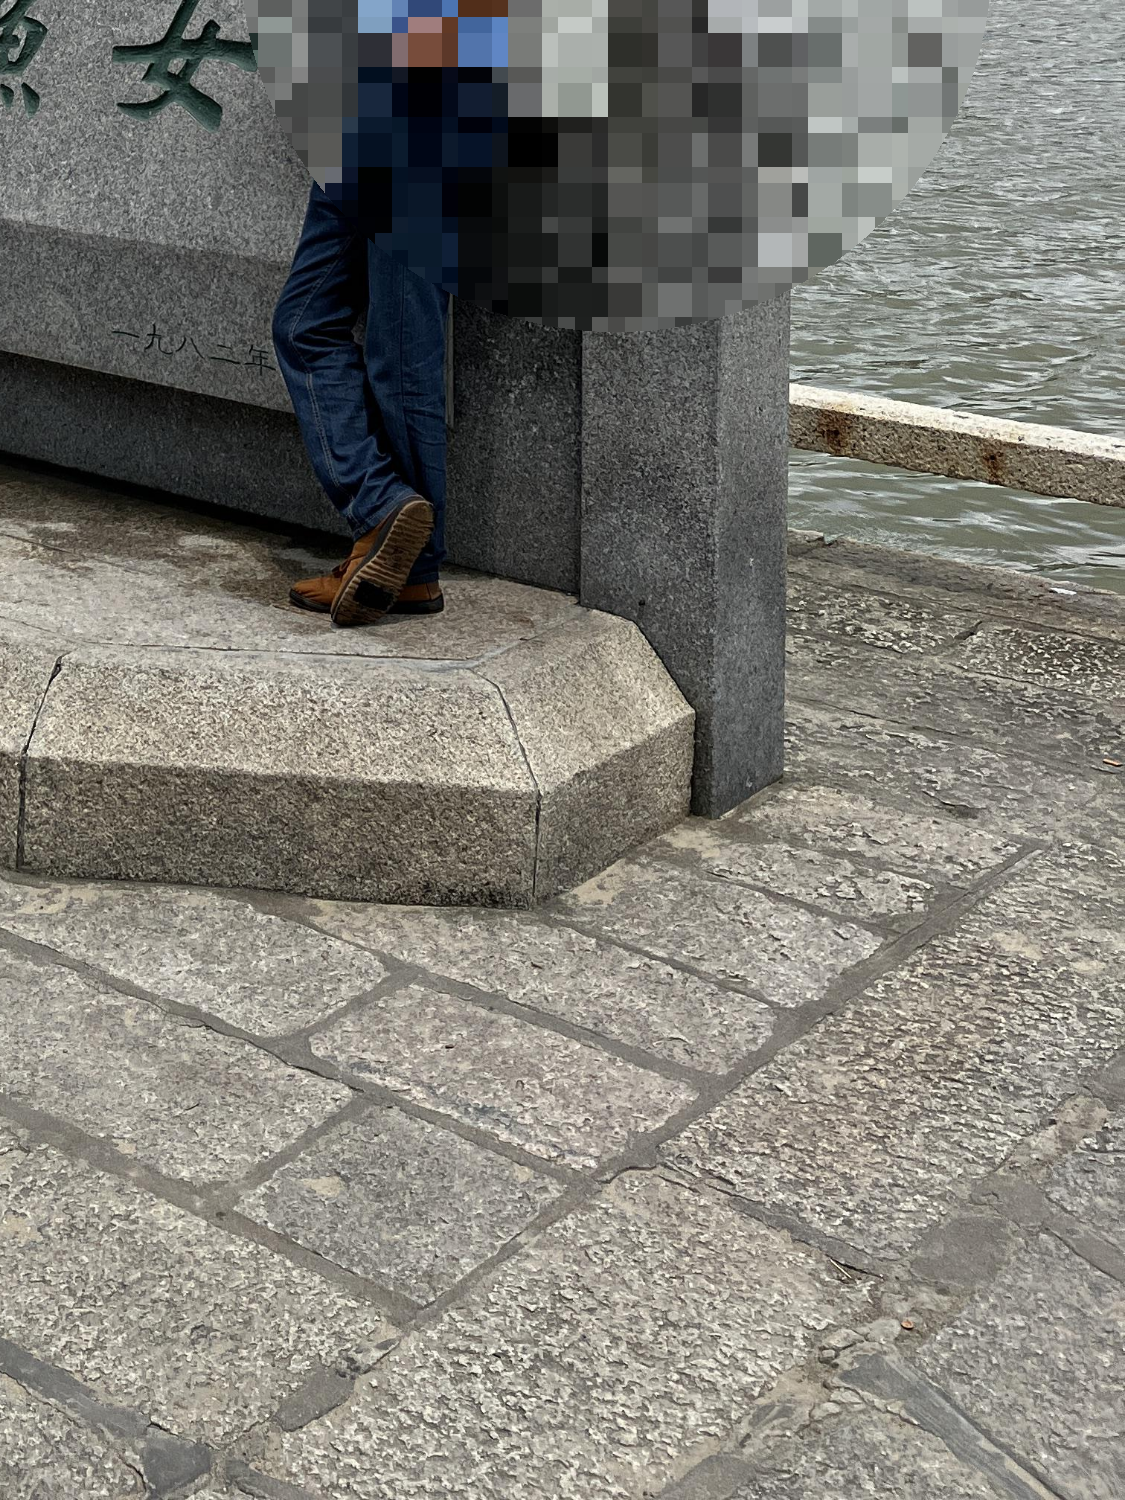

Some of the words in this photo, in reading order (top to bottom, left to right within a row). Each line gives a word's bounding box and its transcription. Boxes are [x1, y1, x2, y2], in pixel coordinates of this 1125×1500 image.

[111, 323, 276, 376] 一九八二年
